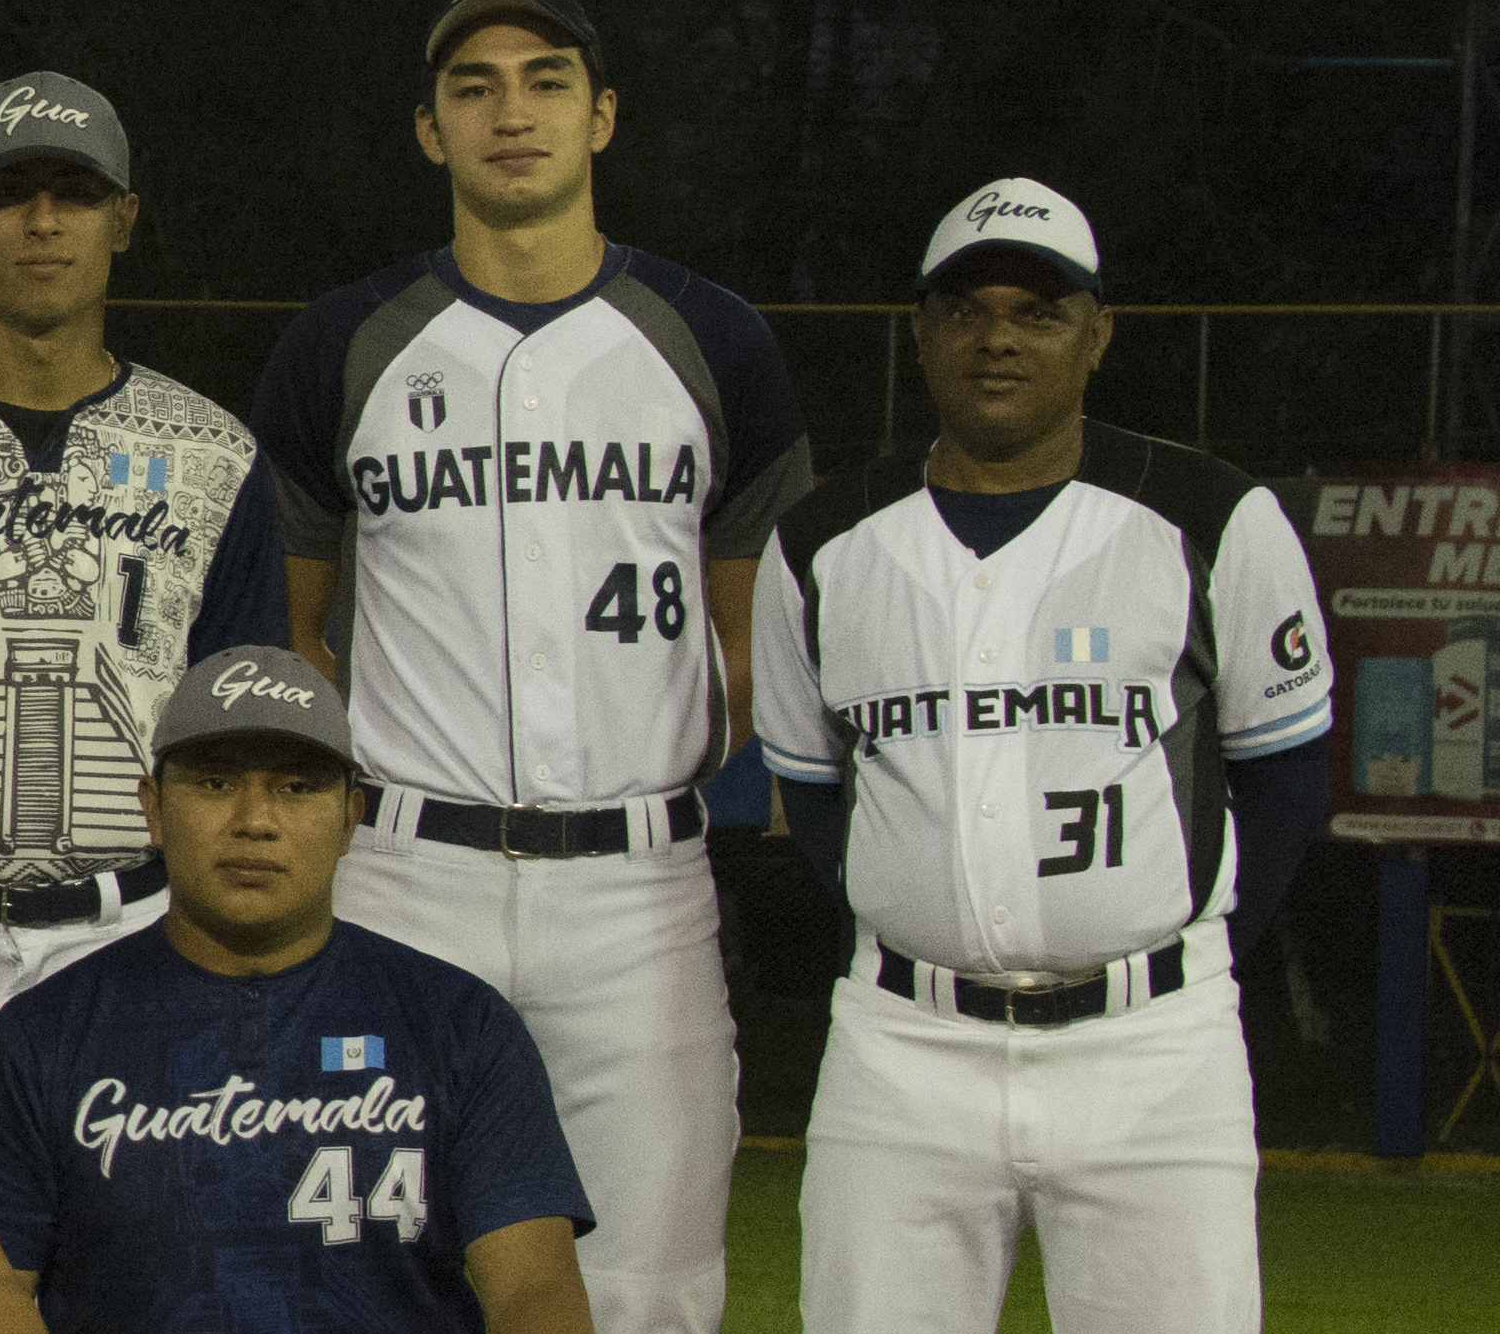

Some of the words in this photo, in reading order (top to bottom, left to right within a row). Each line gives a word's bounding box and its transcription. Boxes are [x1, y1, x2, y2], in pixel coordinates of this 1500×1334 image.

[966, 191, 1051, 233] Gua
[1312, 485, 1500, 537] ENTR
[117, 553, 146, 650] 1
[585, 560, 685, 644] 48
[211, 660, 315, 711] Gua
[1036, 783, 1124, 878] 31
[73, 1074, 426, 1179] Guatemala
[287, 1145, 429, 1246] 44
